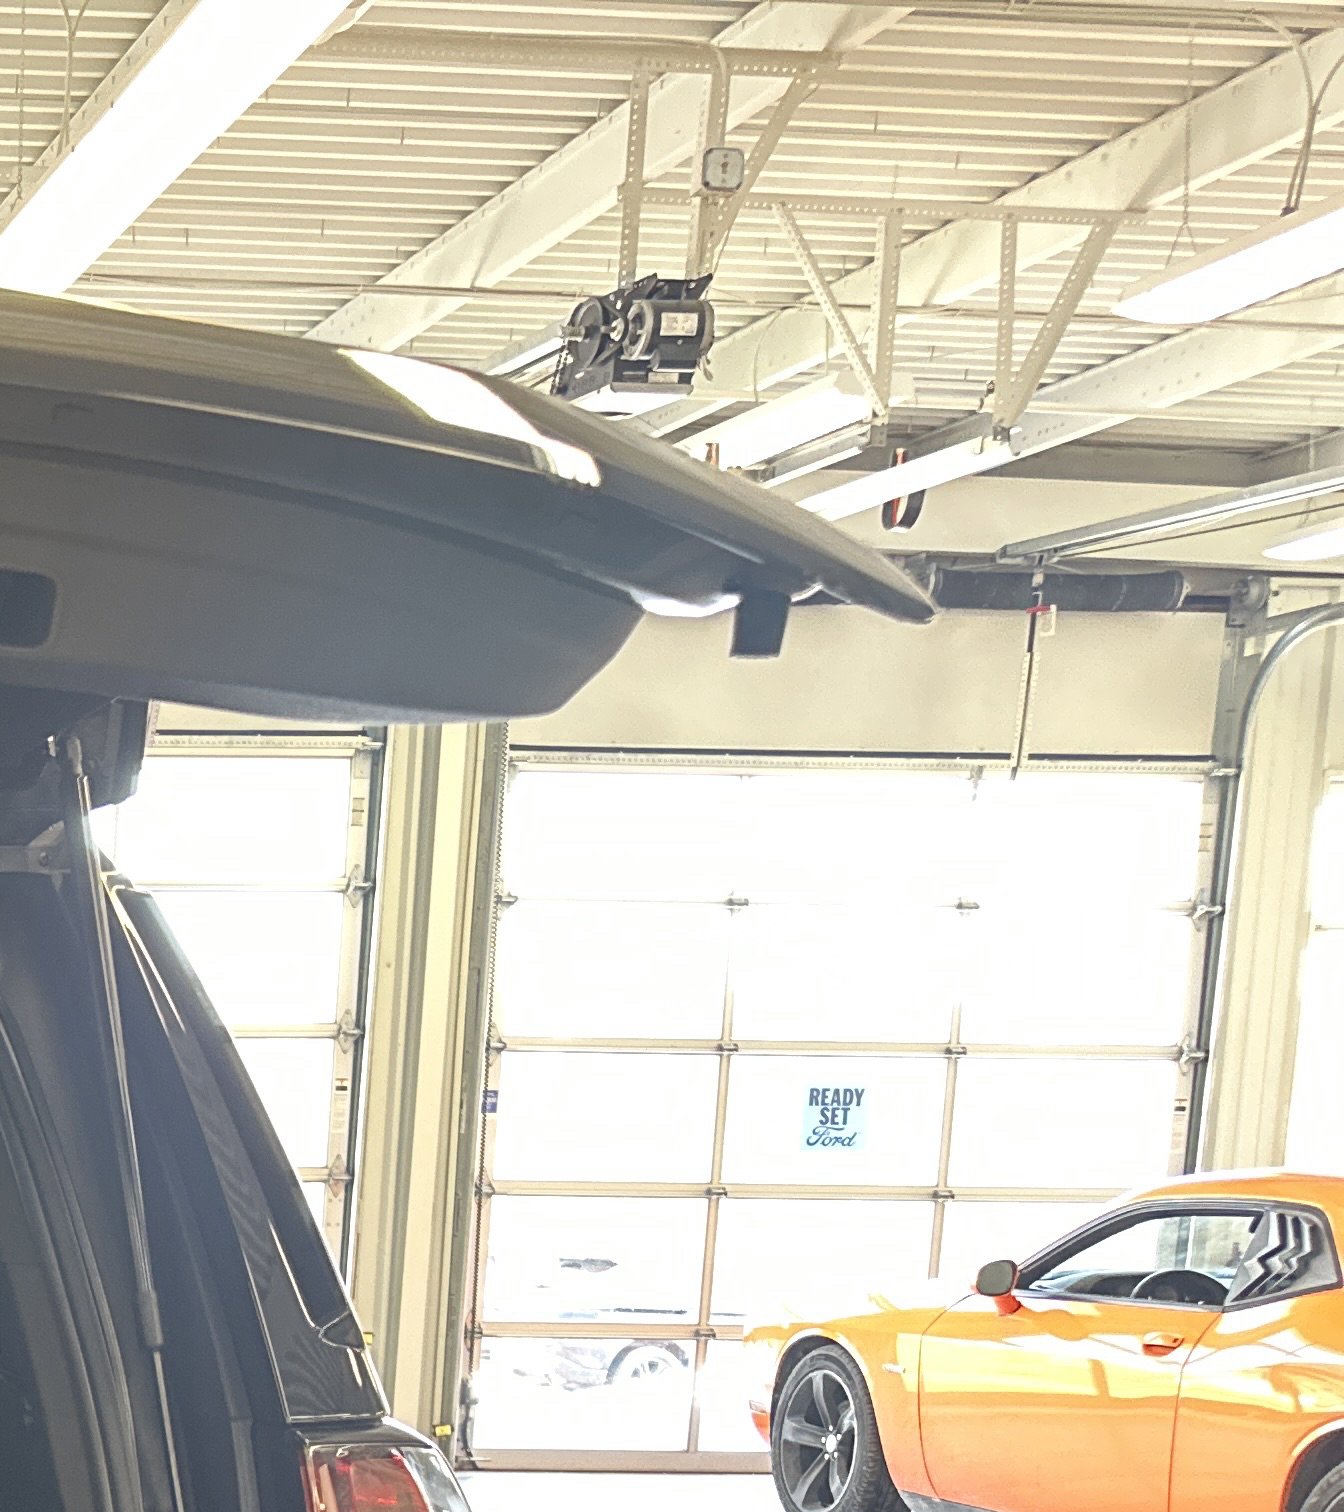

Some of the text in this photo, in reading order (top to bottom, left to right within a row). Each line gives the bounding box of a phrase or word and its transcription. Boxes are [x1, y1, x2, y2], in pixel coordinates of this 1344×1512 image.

[808, 1087, 865, 1106] READY
[818, 1106, 851, 1125] SET
[806, 1125, 857, 1147] Ford
